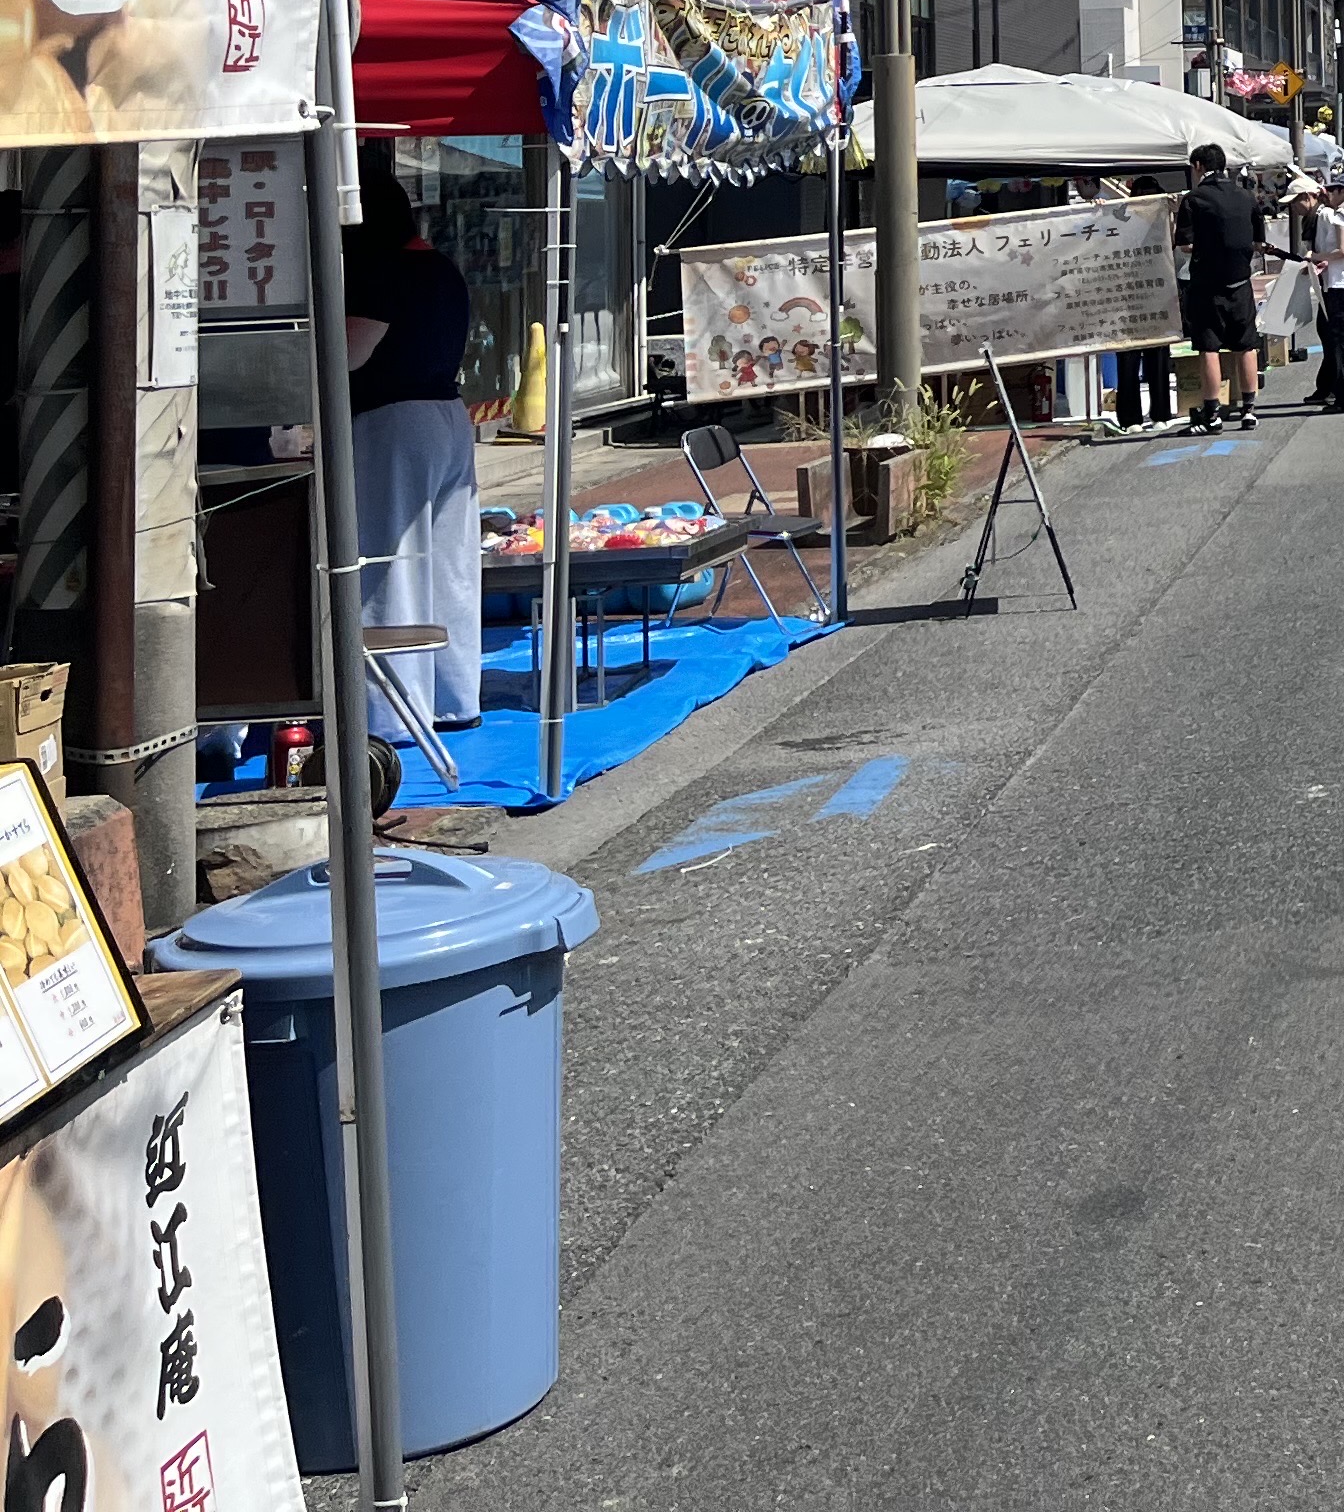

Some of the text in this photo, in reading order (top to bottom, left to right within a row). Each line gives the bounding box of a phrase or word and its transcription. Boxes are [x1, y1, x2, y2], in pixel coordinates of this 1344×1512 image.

[995, 223, 1120, 252] フェリーチェ
[145, 1091, 201, 1421] 近江庵
